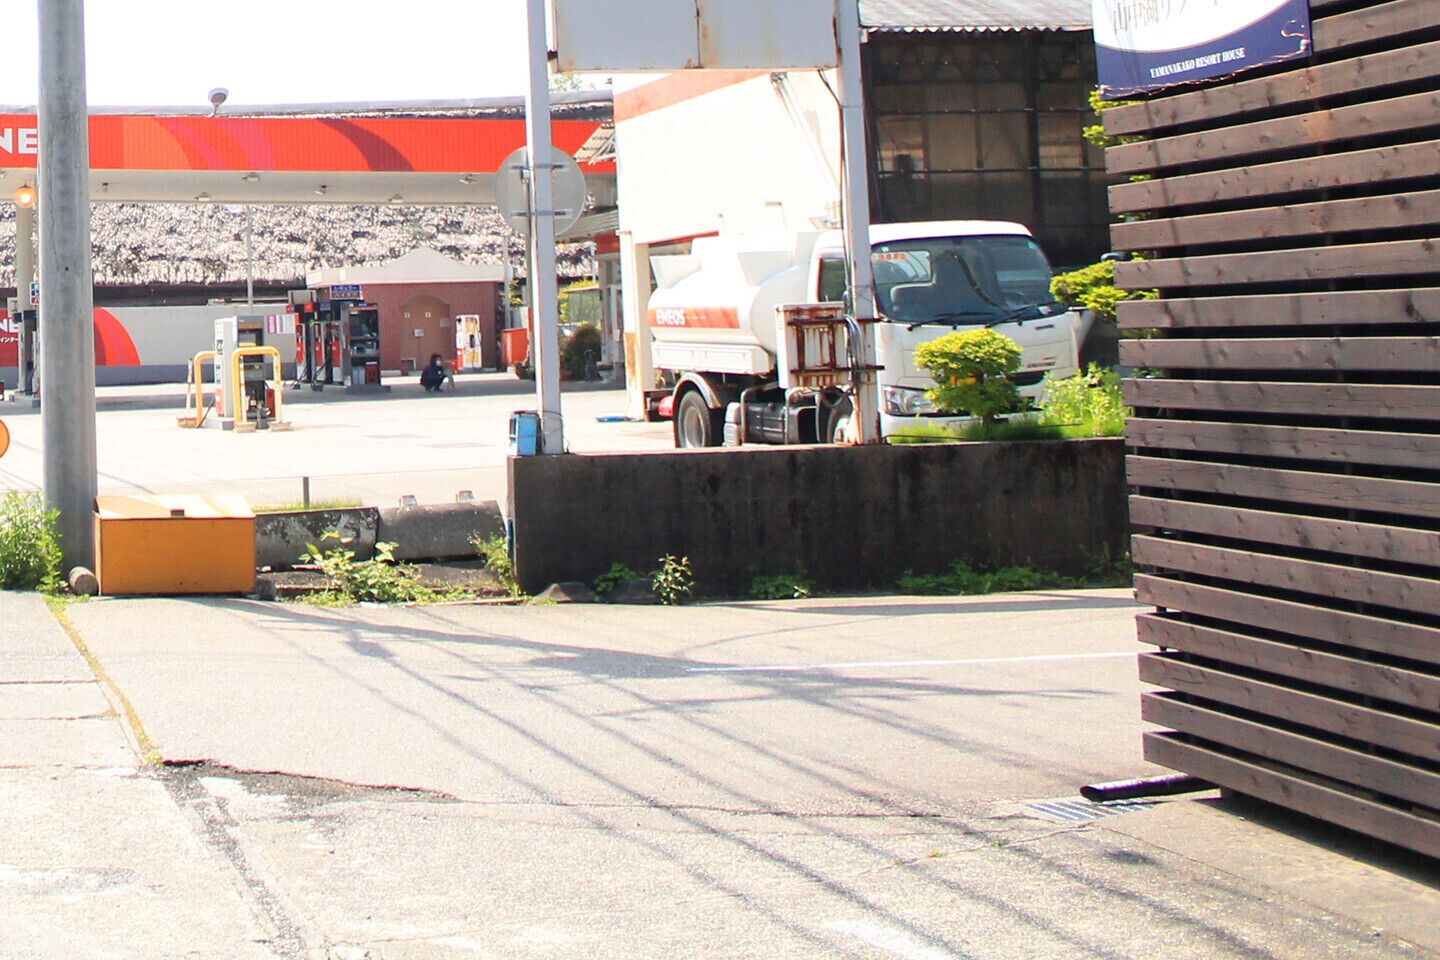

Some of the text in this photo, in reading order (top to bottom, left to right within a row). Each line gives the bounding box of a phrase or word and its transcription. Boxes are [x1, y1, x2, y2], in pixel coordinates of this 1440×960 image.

[1149, 47, 1246, 78] YAMANAKAKO RESORT HOUSE
[655, 308, 686, 326] ENEOS
